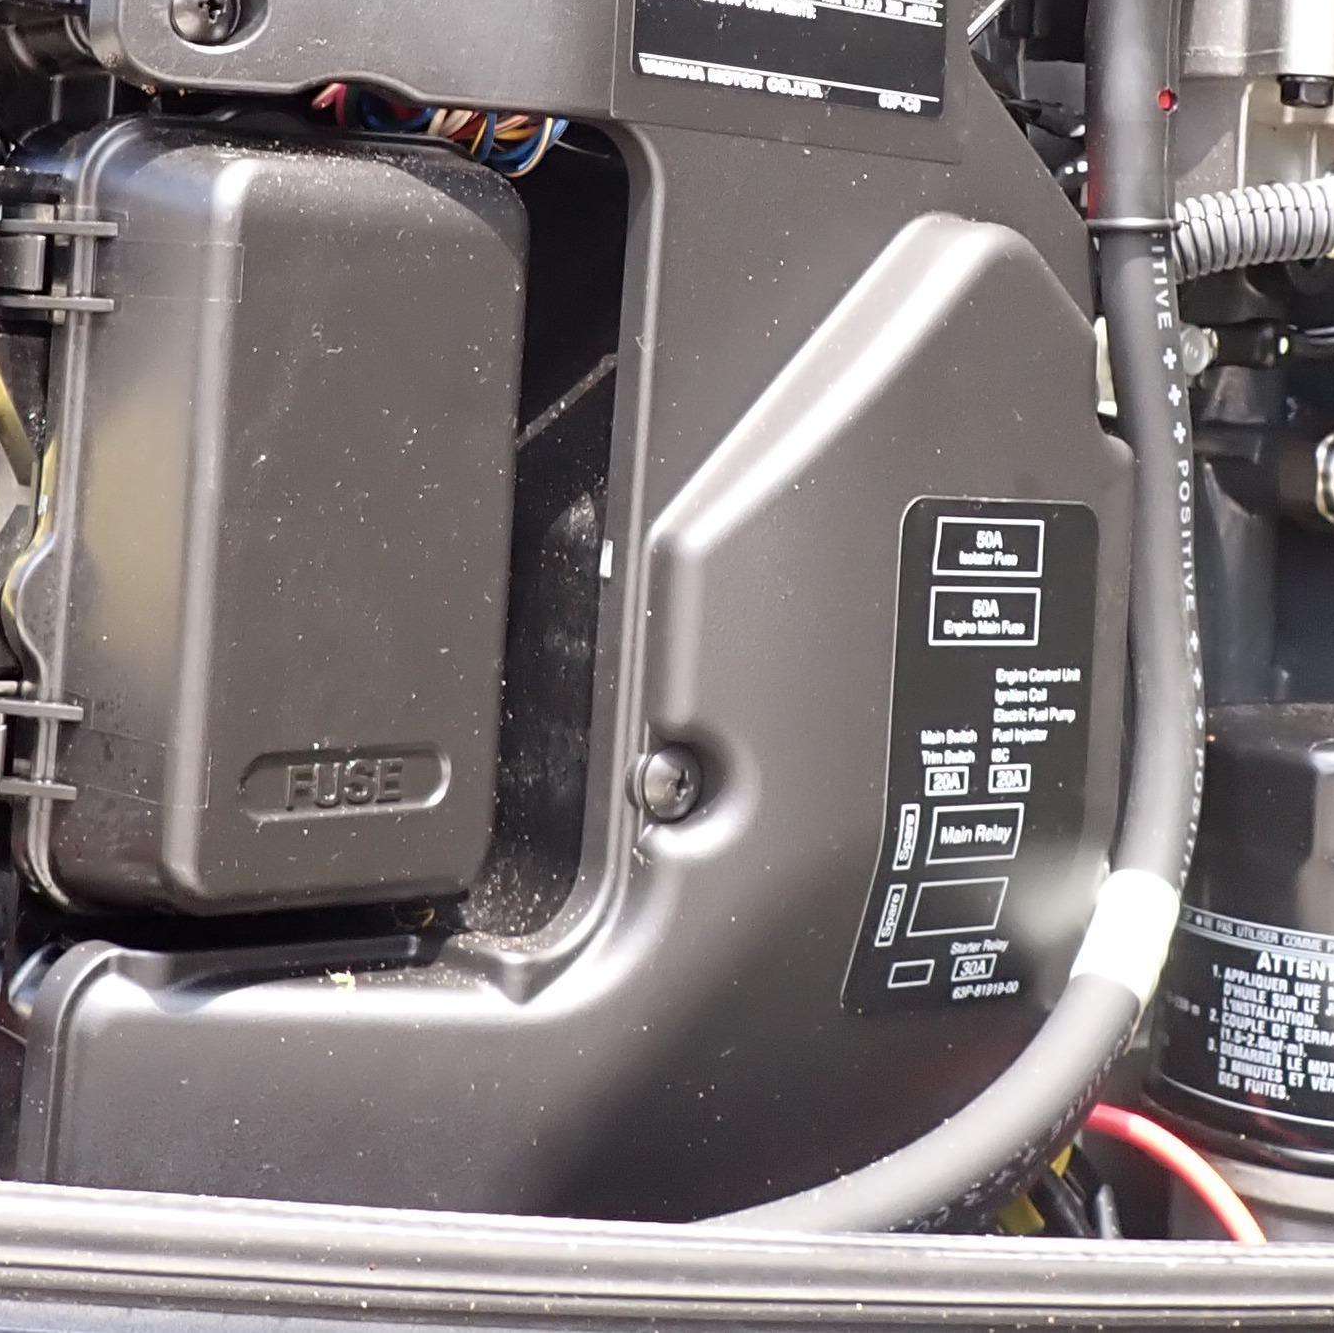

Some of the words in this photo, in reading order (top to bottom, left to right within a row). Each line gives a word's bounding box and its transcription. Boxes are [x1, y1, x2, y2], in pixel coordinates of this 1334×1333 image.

[976, 530, 1003, 549] 50A
[1177, 459, 1197, 613] POSITIVE
[972, 599, 999, 618] 50A
[1049, 706, 1076, 724] Pump
[921, 750, 943, 765] Trim
[286, 756, 405, 811] FUSE
[932, 772, 961, 791] 20A
[996, 769, 1023, 788] 20A
[898, 813, 915, 862] Spare
[940, 825, 973, 845] Main
[974, 823, 1013, 845] Relay
[881, 892, 901, 938] Spare
[981, 938, 1010, 955] Relay
[1237, 923, 1279, 944] UTILISER
[1282, 932, 1323, 951] COMME
[959, 960, 987, 977] 30A
[1224, 967, 1288, 994] APPLIQUER
[1295, 981, 1321, 999] UNE
[1223, 982, 1267, 1004] D'HUILE
[1271, 992, 1298, 1011] SUR
[1304, 998, 1320, 1015] LE
[1209, 1007, 1219, 1022] 2.
[1221, 1012, 1266, 1035] COUPLE
[1271, 1024, 1289, 1039] DE
[1222, 997, 1319, 1029] L'INSTALLATION.
[1219, 1056, 1227, 1070] 3
[1231, 1060, 1283, 1084] MINUTES
[1288, 1072, 1305, 1088] ET
[1287, 1057, 1303, 1071] LE
[1218, 1071, 1240, 1089] DES
[1244, 1074, 1290, 1101] FUITES.
